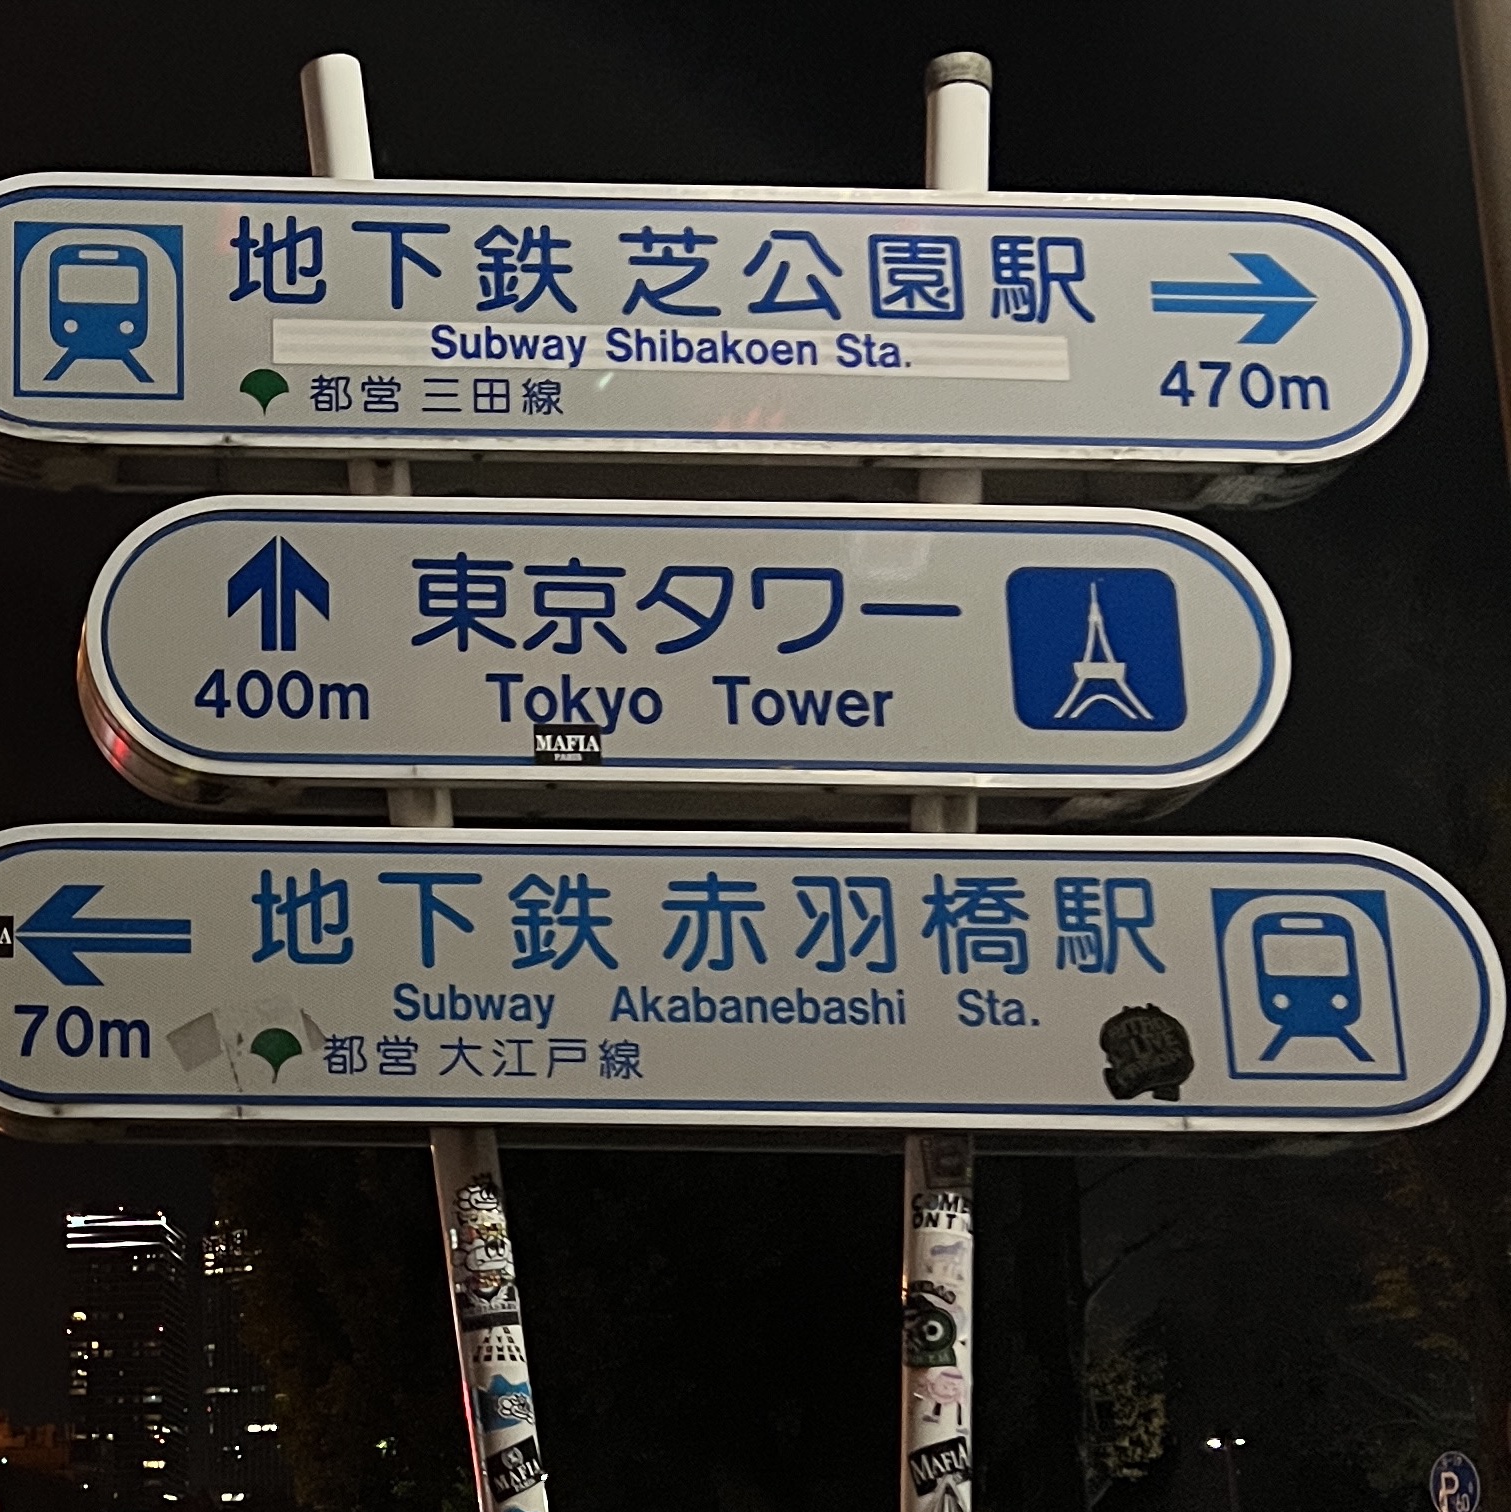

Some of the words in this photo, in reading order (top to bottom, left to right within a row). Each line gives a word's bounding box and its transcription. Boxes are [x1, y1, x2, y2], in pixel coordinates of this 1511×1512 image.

[230, 215, 578, 315] 地下鉄
[619, 225, 1096, 324] 芝公園駅
[430, 325, 586, 369] Subway
[605, 328, 817, 367] Shibakoen
[836, 334, 911, 369] Sta.
[310, 376, 401, 413] 都営
[422, 377, 564, 416] 三田線
[1160, 361, 1330, 411] 470m
[411, 551, 962, 654] 東京タワー
[195, 669, 370, 720] 400m
[486, 674, 662, 734] Tokyo
[712, 676, 893, 727] Tower
[535, 734, 600, 753] MAFIA
[251, 868, 618, 970] 地下鉄
[662, 871, 1167, 977] 赤羽橋駅
[393, 984, 556, 1029] Subway
[609, 985, 906, 1027] Akabanebashi
[957, 989, 1040, 1027] Sta.
[13, 1005, 151, 1059] 70m
[323, 1036, 419, 1077] 都営
[439, 1037, 644, 1079] 大江戸線
[910, 1443, 971, 1484] MAFIA
